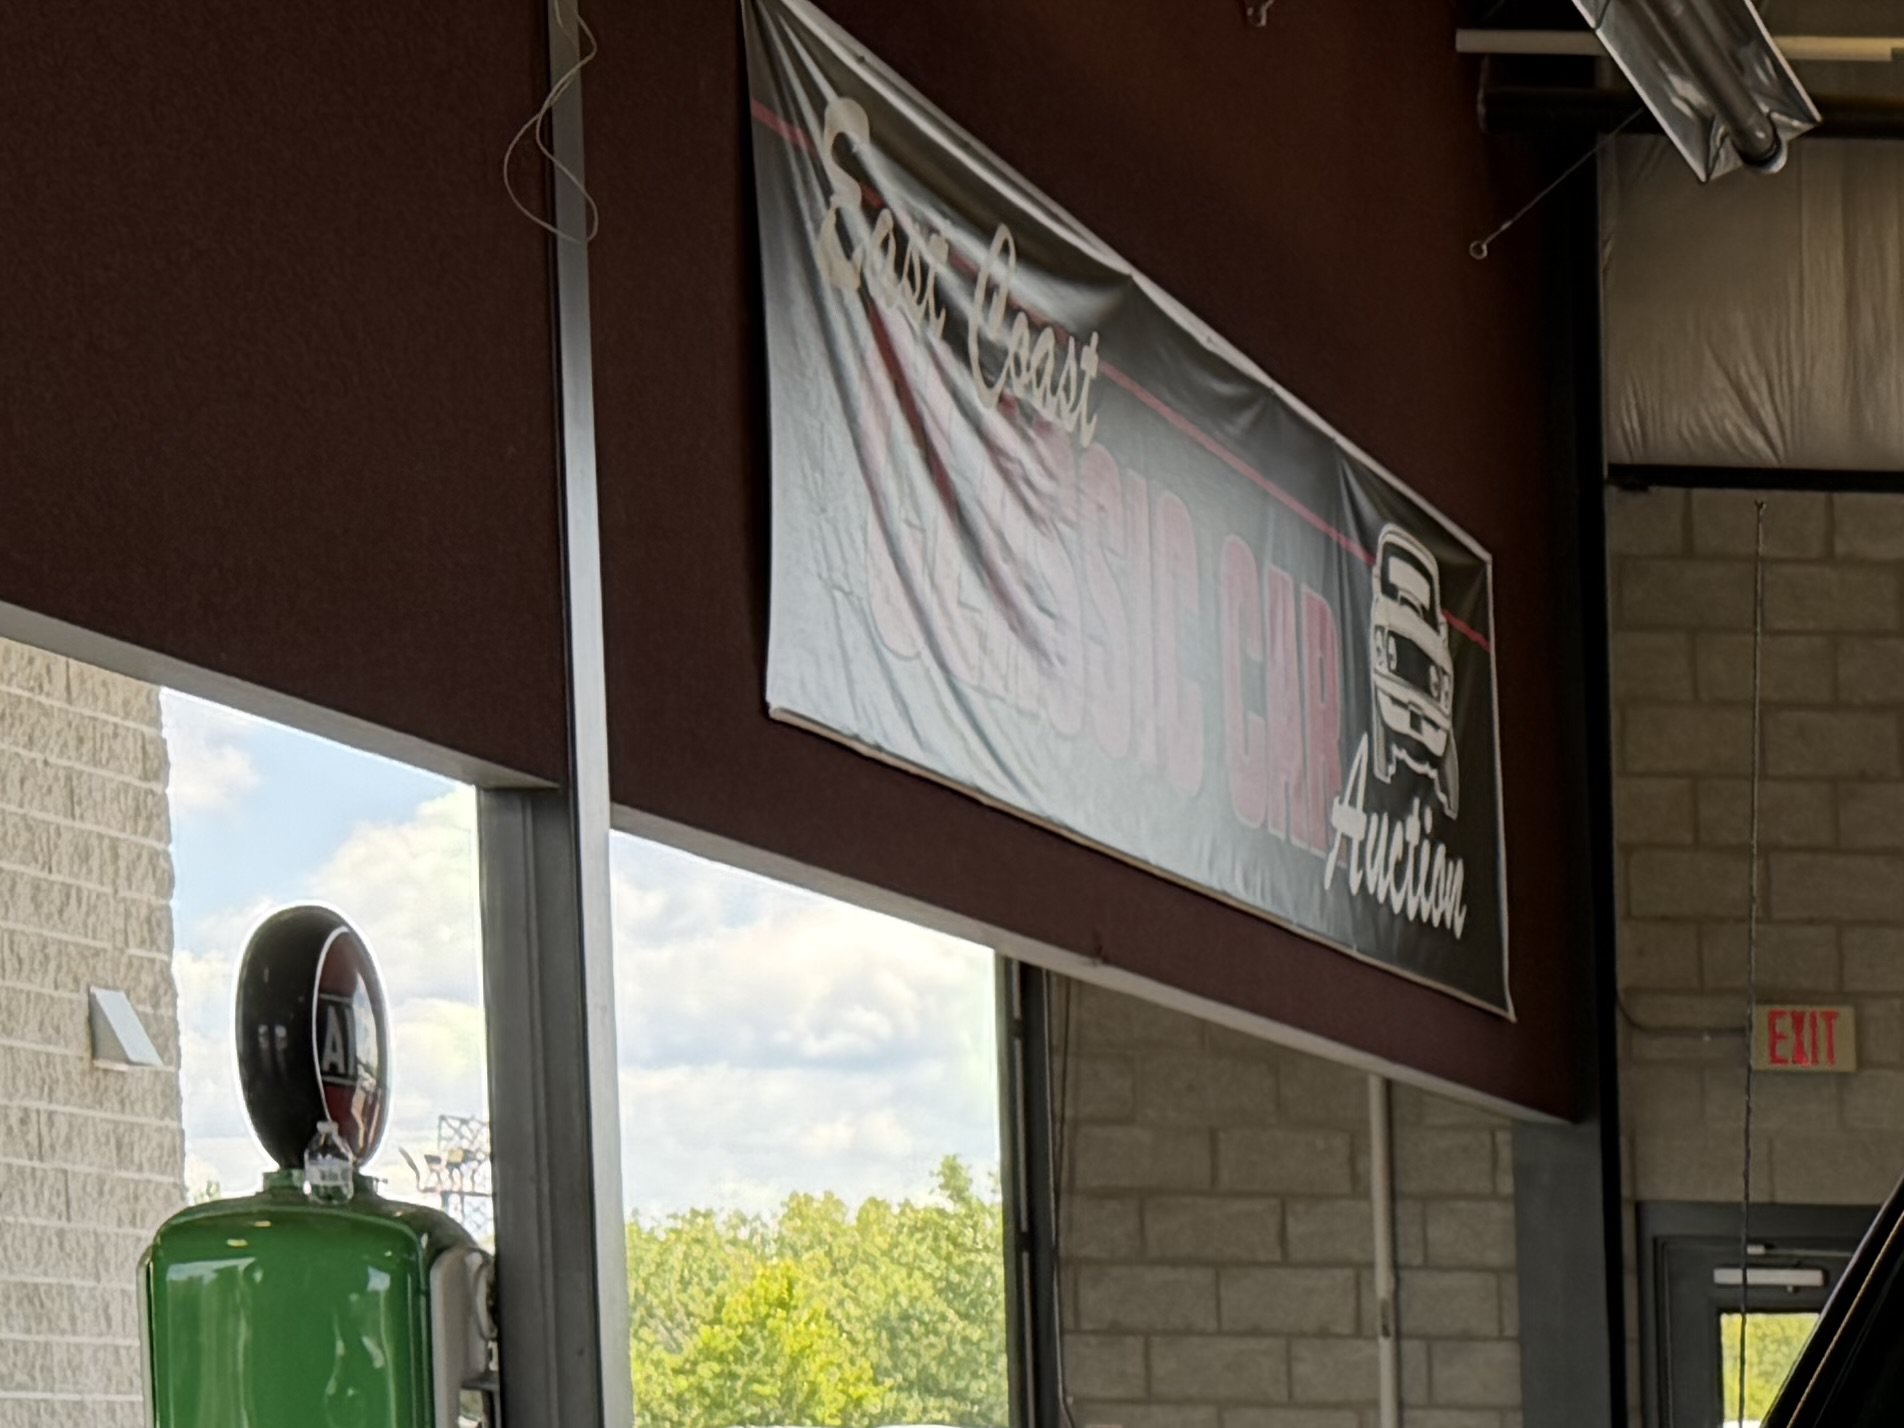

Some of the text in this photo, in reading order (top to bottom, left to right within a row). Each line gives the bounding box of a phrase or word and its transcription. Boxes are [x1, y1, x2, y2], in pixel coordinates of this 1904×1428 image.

[816, 97, 1098, 448] East Coast
[1221, 534, 1348, 868] CAR
[1325, 731, 1467, 940] Auction
[1767, 1008, 1840, 1067] EXIT
